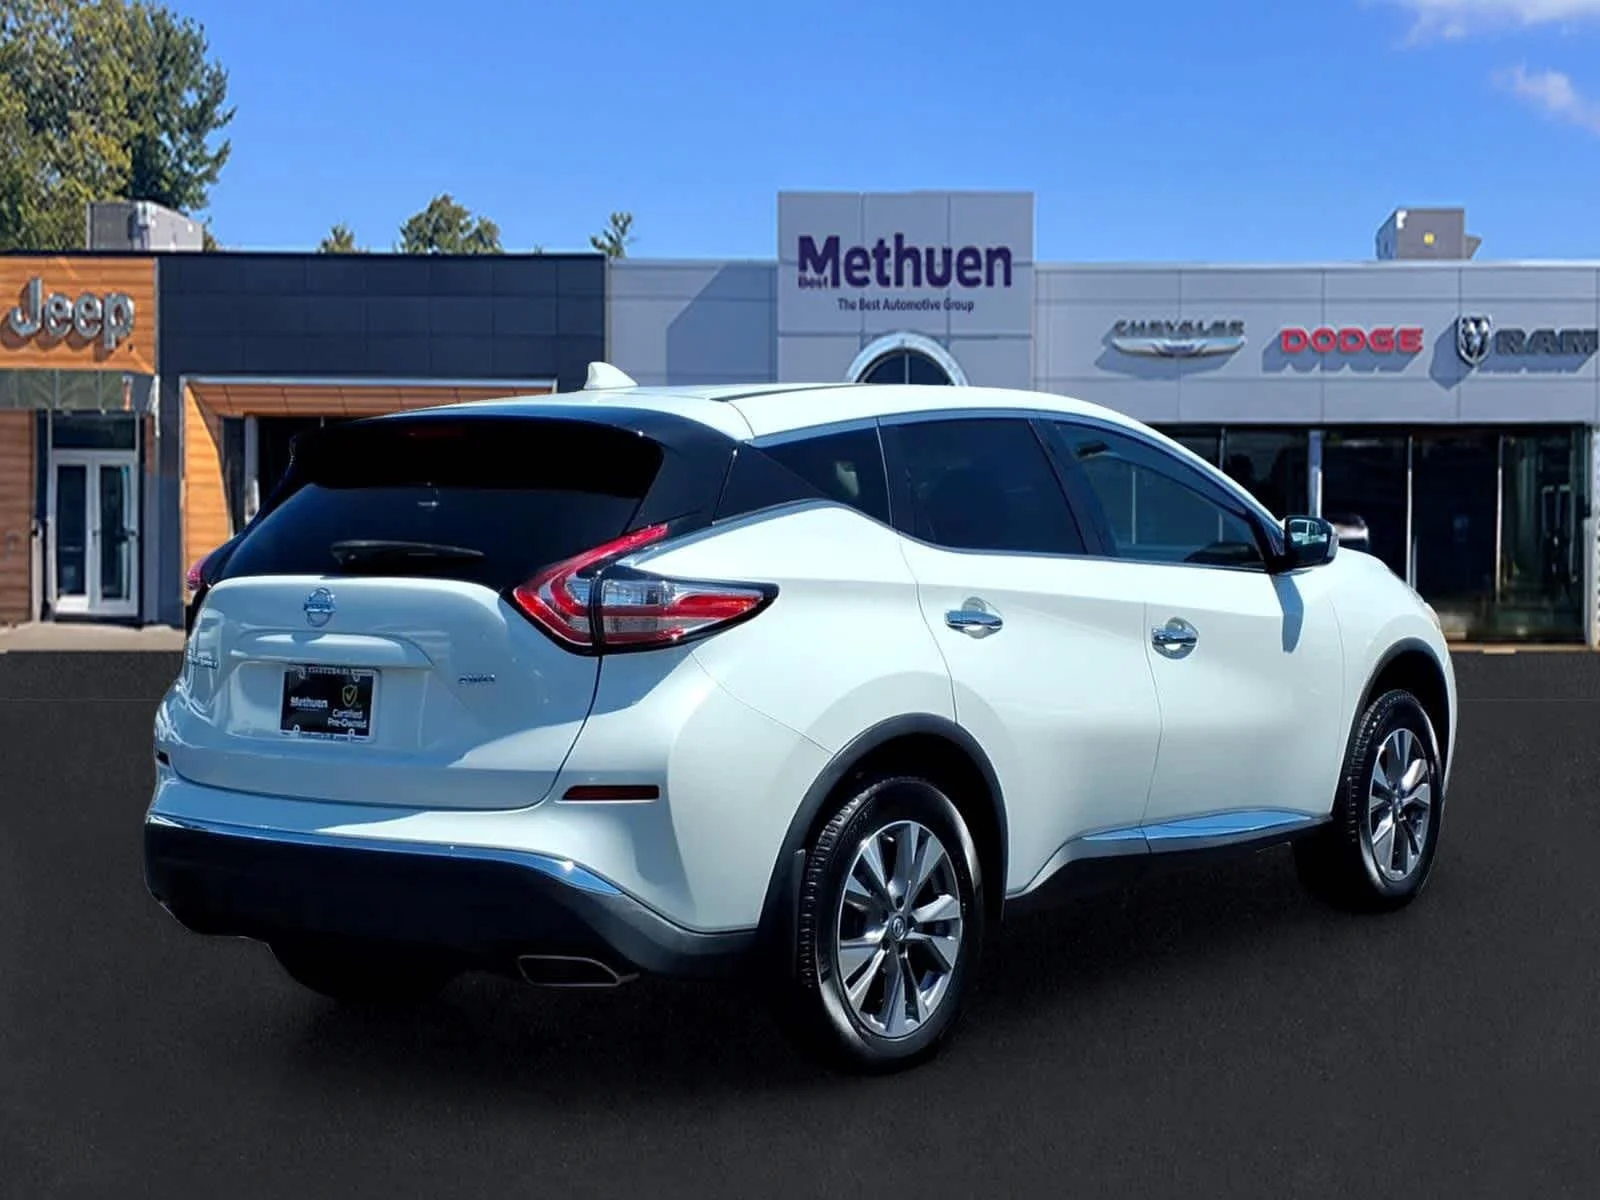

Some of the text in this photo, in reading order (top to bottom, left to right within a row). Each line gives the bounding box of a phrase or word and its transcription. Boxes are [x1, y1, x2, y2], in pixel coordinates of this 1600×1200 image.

[798, 233, 1012, 288] Methuen
[9, 277, 135, 349] Jeep
[838, 298, 974, 313] The Best Automotive Group
[1281, 327, 1424, 353] DODGE
[1496, 328, 1598, 355] RAM
